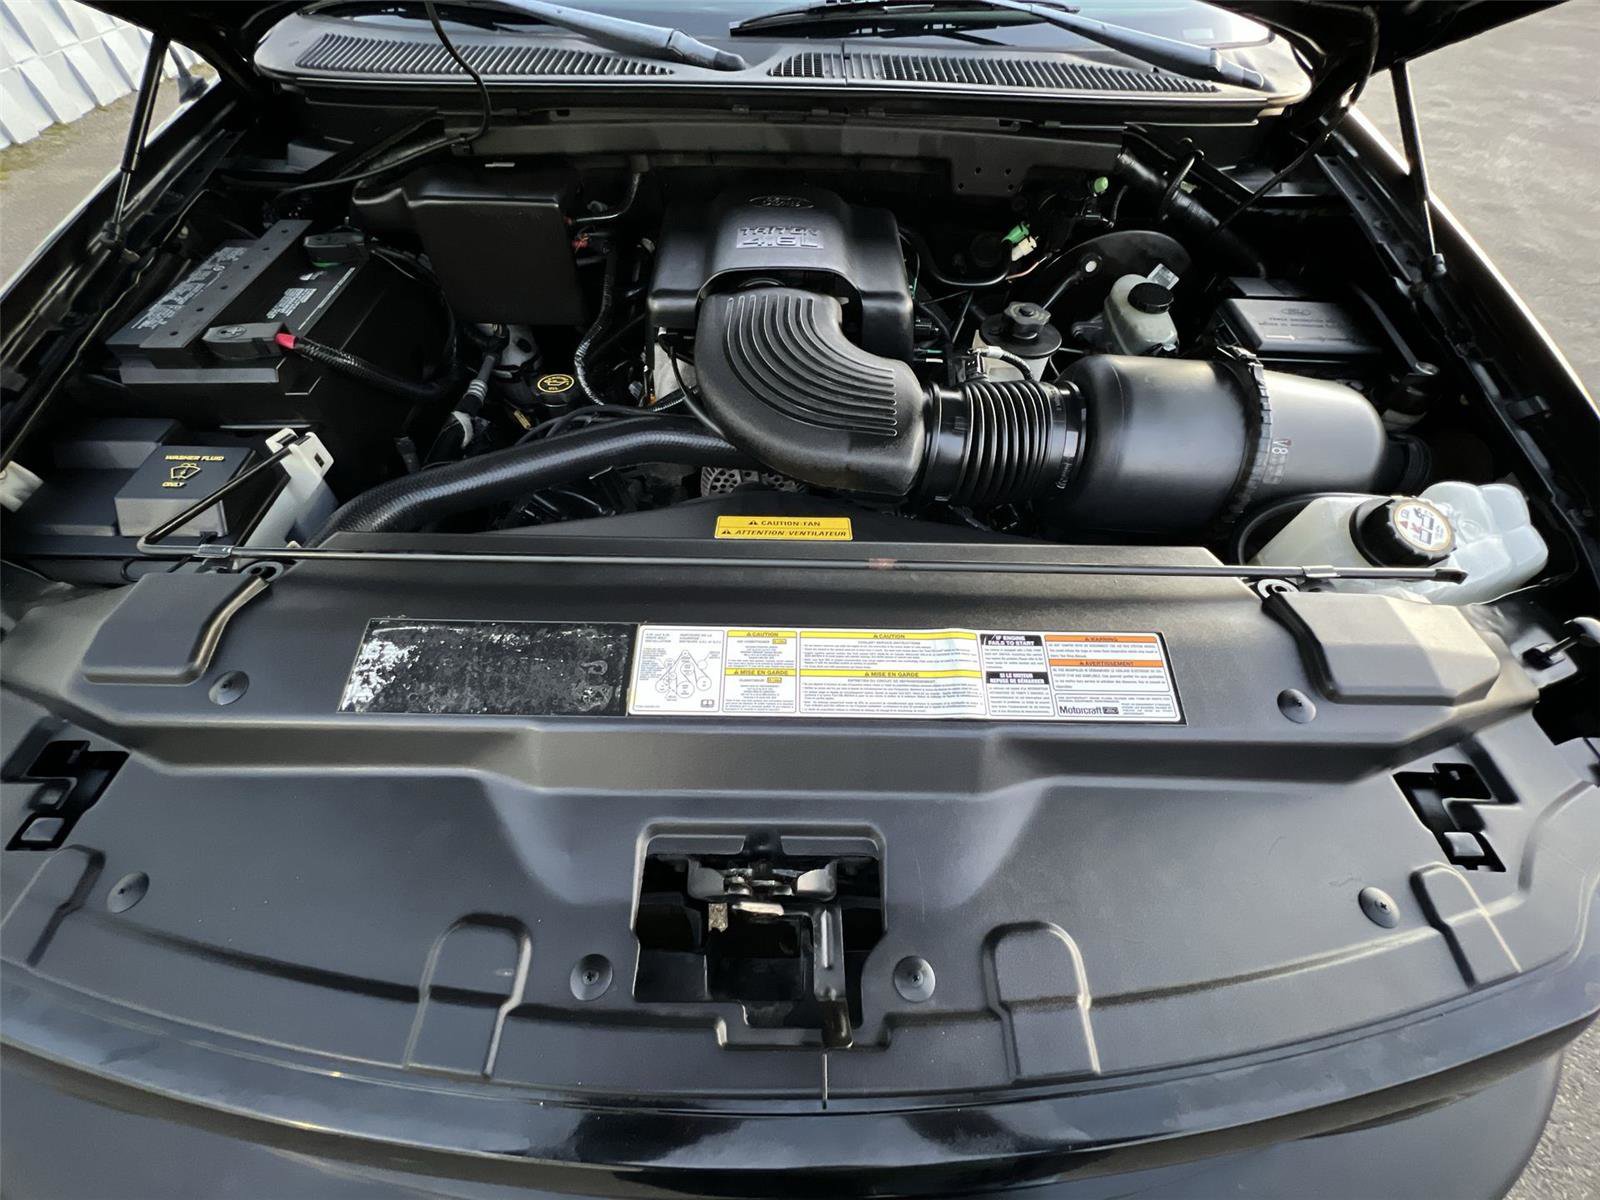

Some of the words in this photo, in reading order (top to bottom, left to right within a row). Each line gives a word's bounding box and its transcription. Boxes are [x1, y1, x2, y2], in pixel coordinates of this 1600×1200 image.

[738, 226, 820, 236] TRITON
[742, 235, 819, 248] 4.6L
[1059, 705, 1102, 715] Motorcraft
